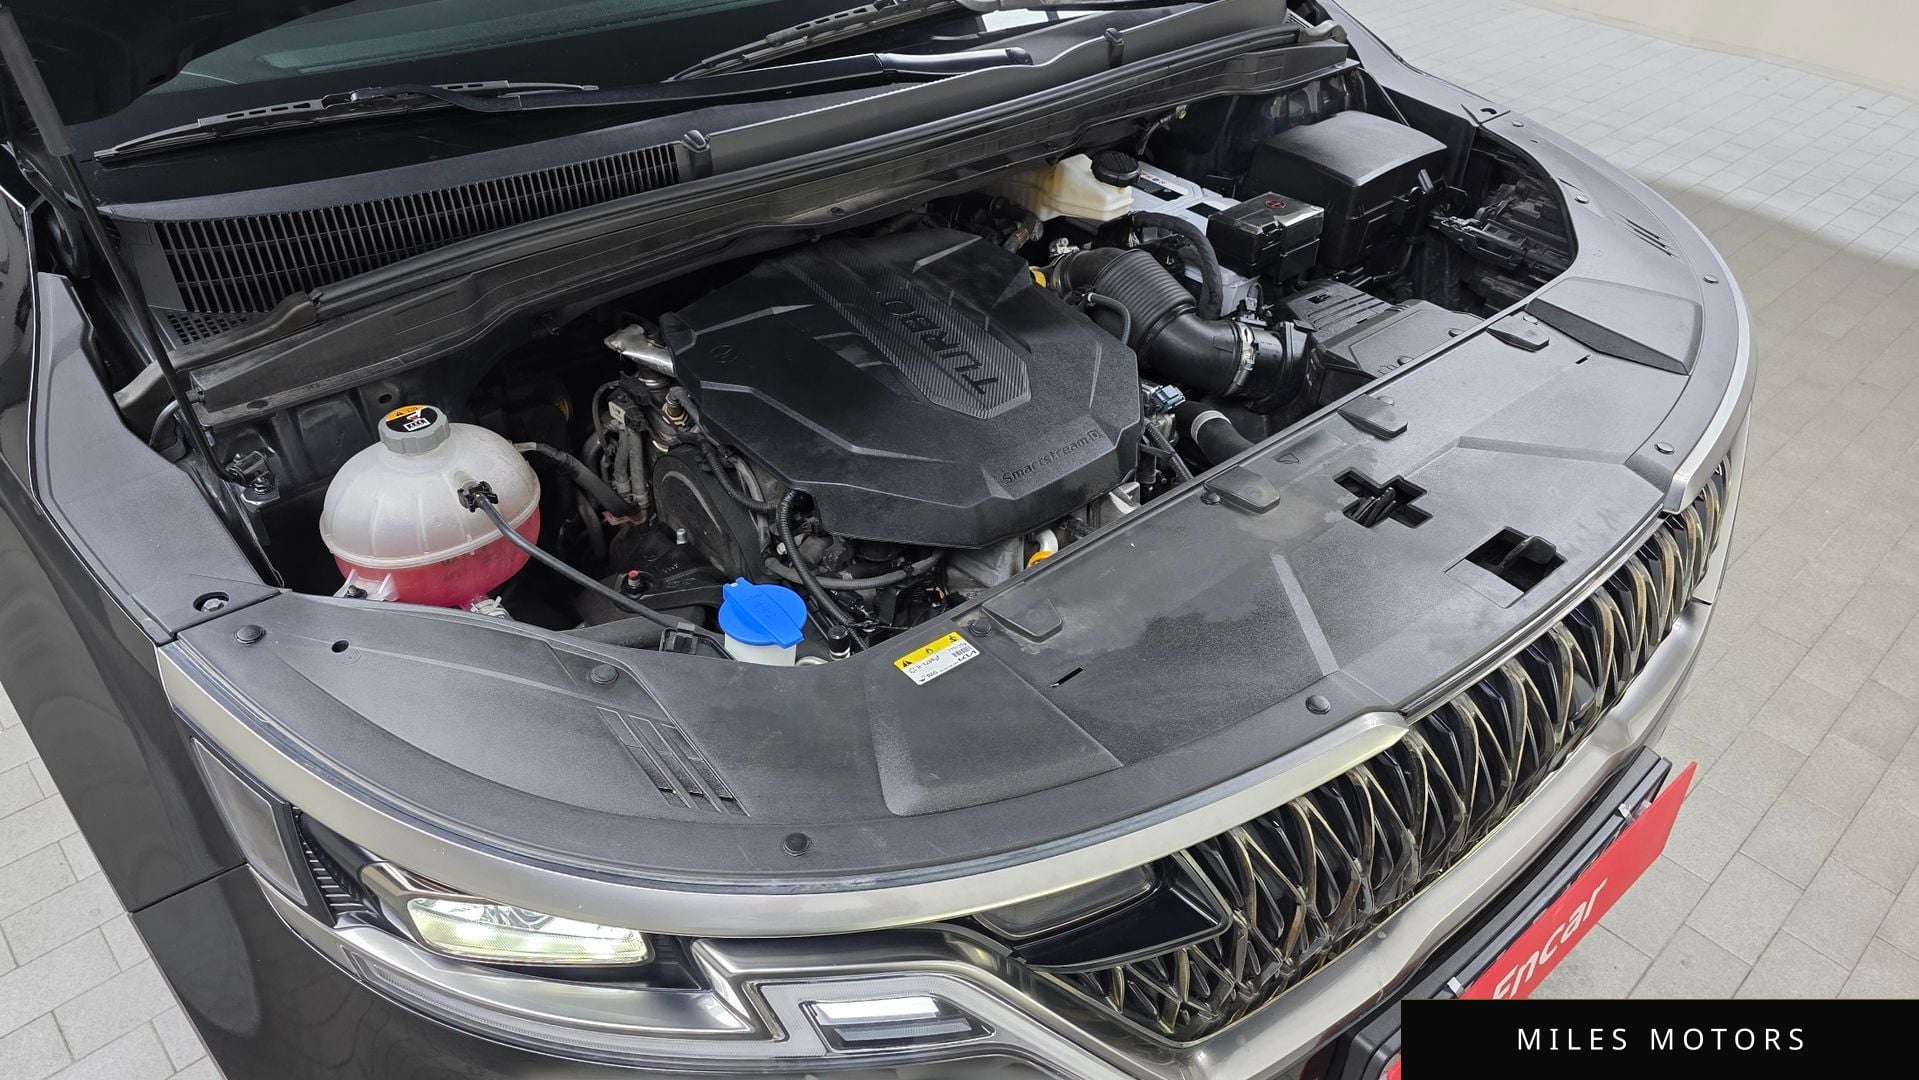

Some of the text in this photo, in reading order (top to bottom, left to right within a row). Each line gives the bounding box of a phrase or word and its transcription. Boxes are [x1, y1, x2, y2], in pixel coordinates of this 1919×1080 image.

[881, 299, 999, 395] TURBO
[1001, 437, 1089, 486] Smartstream
[1492, 877, 1608, 999] Encar
